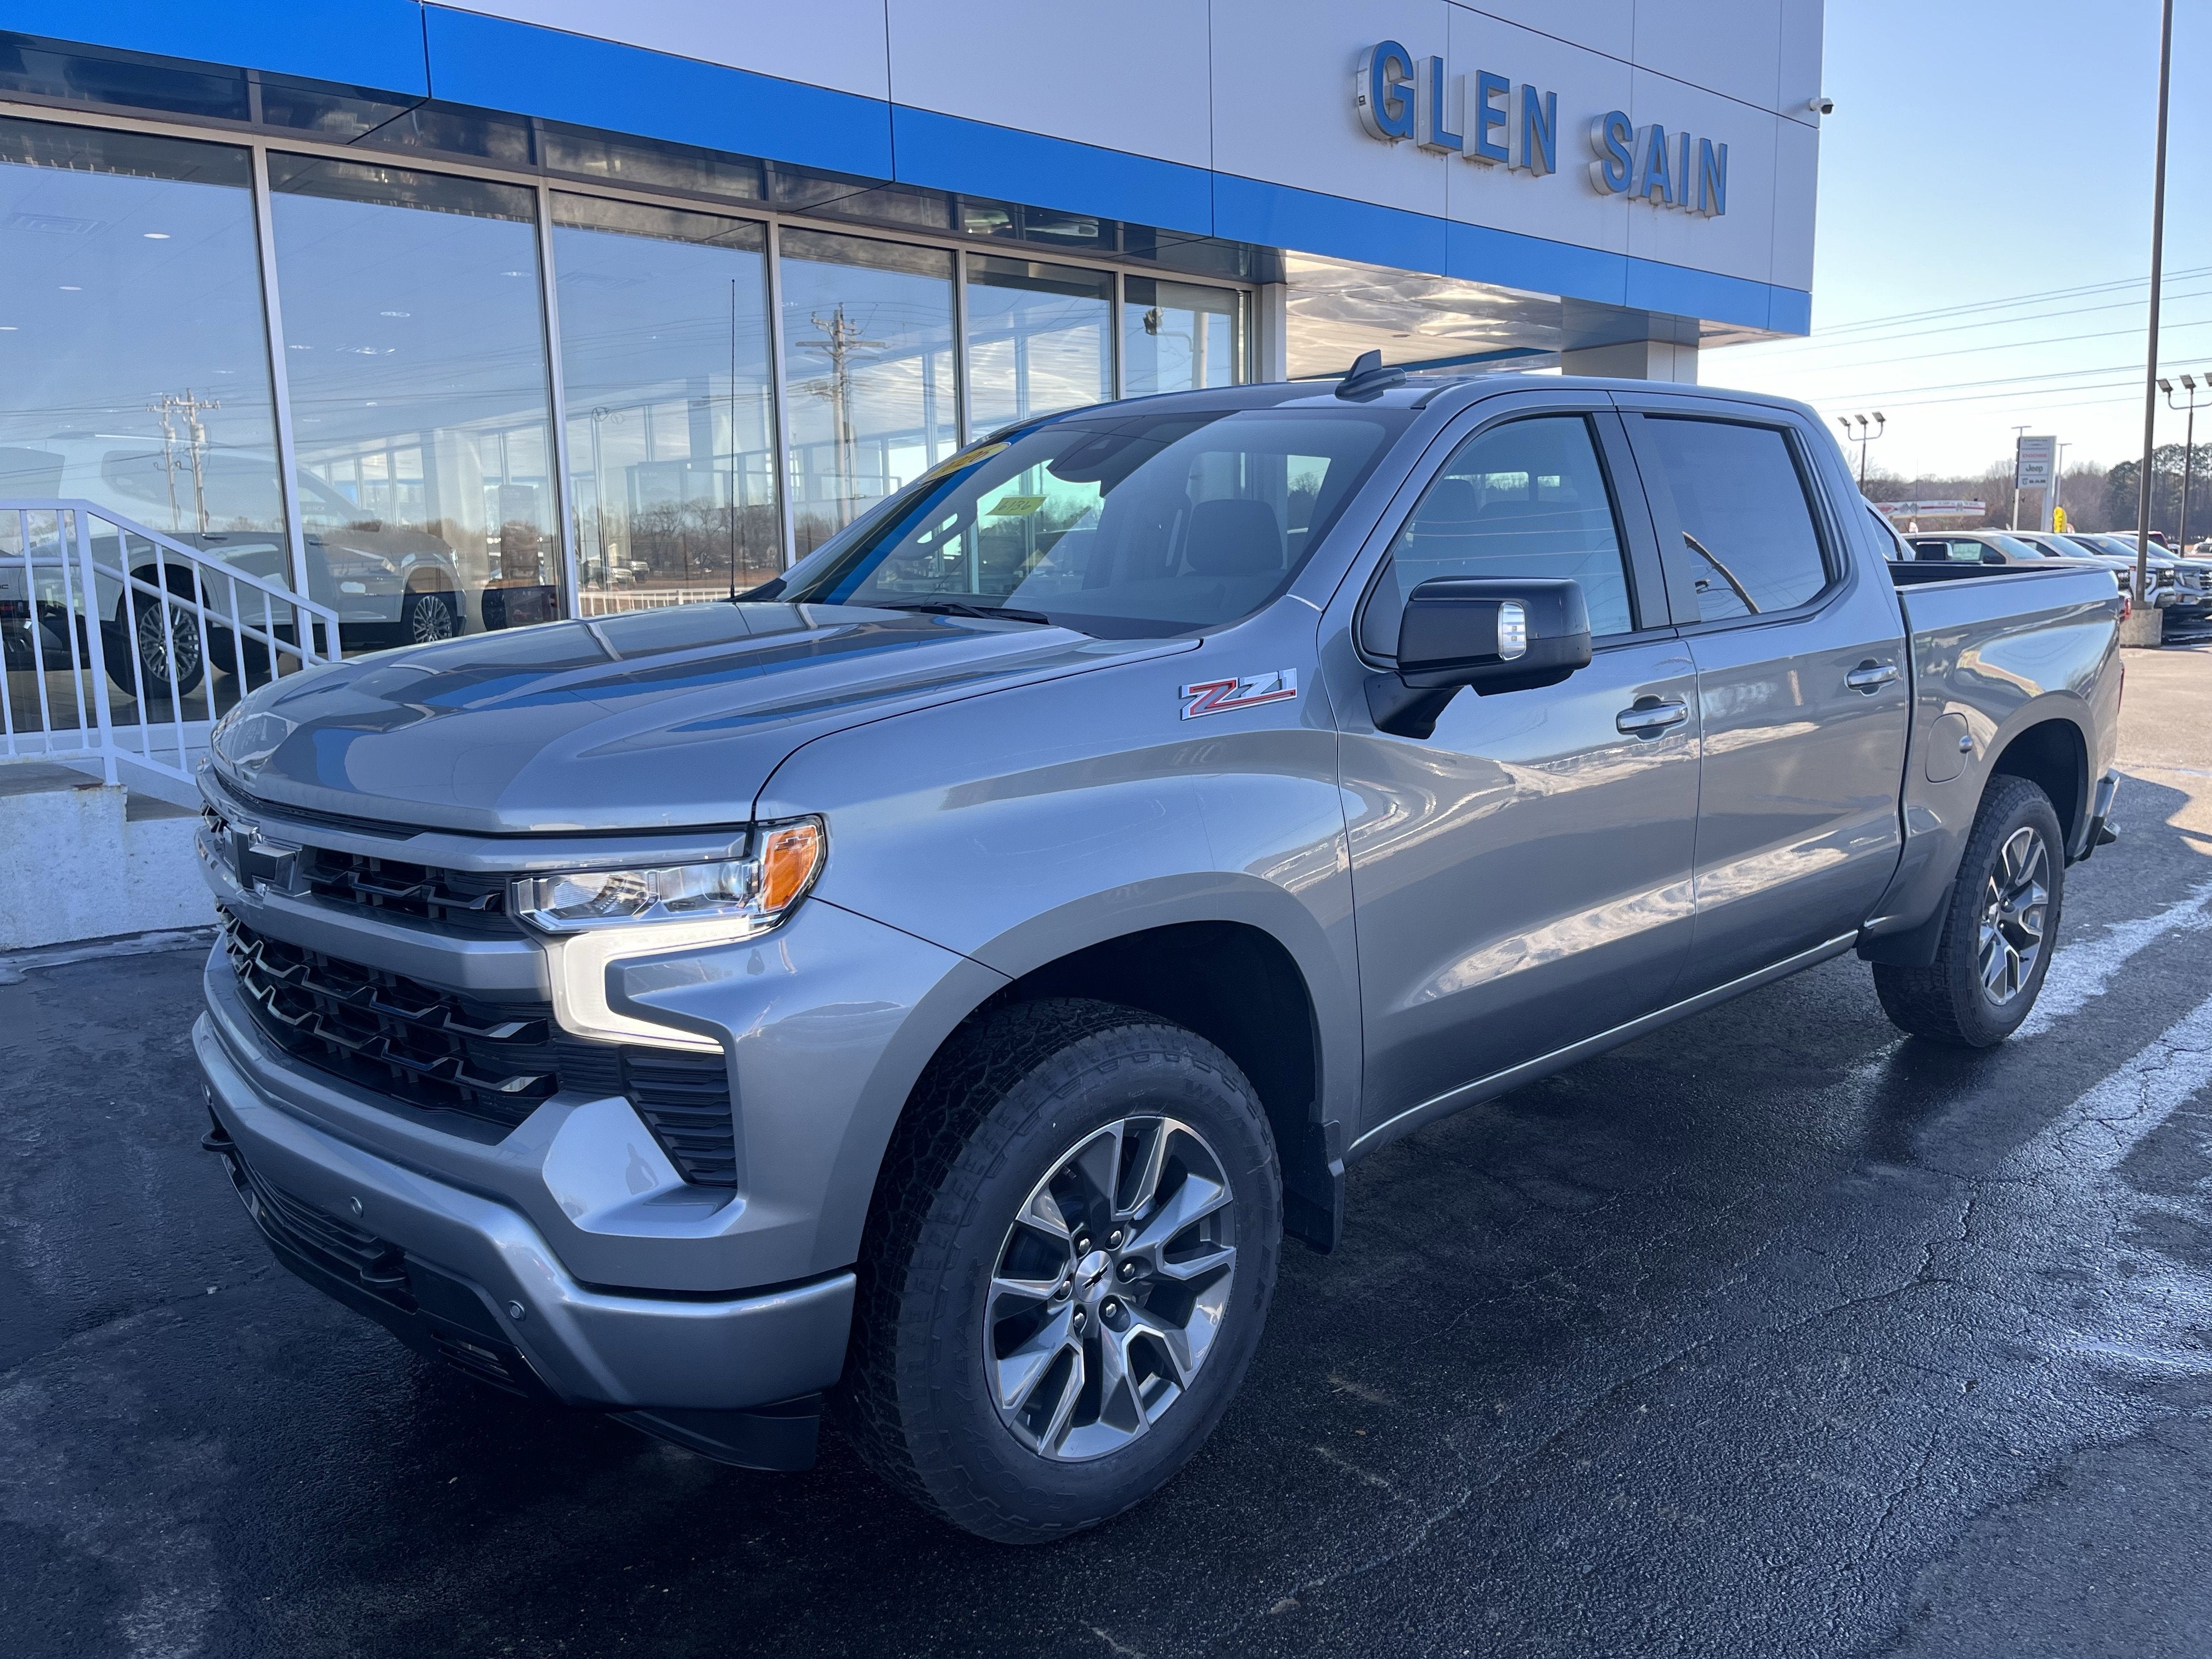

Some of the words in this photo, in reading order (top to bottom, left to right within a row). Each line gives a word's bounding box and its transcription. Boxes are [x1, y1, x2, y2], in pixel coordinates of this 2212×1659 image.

[1359, 40, 1558, 176] GLEN
[1592, 110, 1728, 217] SAIN
[997, 500, 1032, 511] 6136
[2025, 464, 2044, 473] Jeep
[1180, 667, 1297, 721] Z71
[1182, 1075, 1274, 1312] WRANGLER
[952, 1254, 1080, 1510] GOODYEAR
